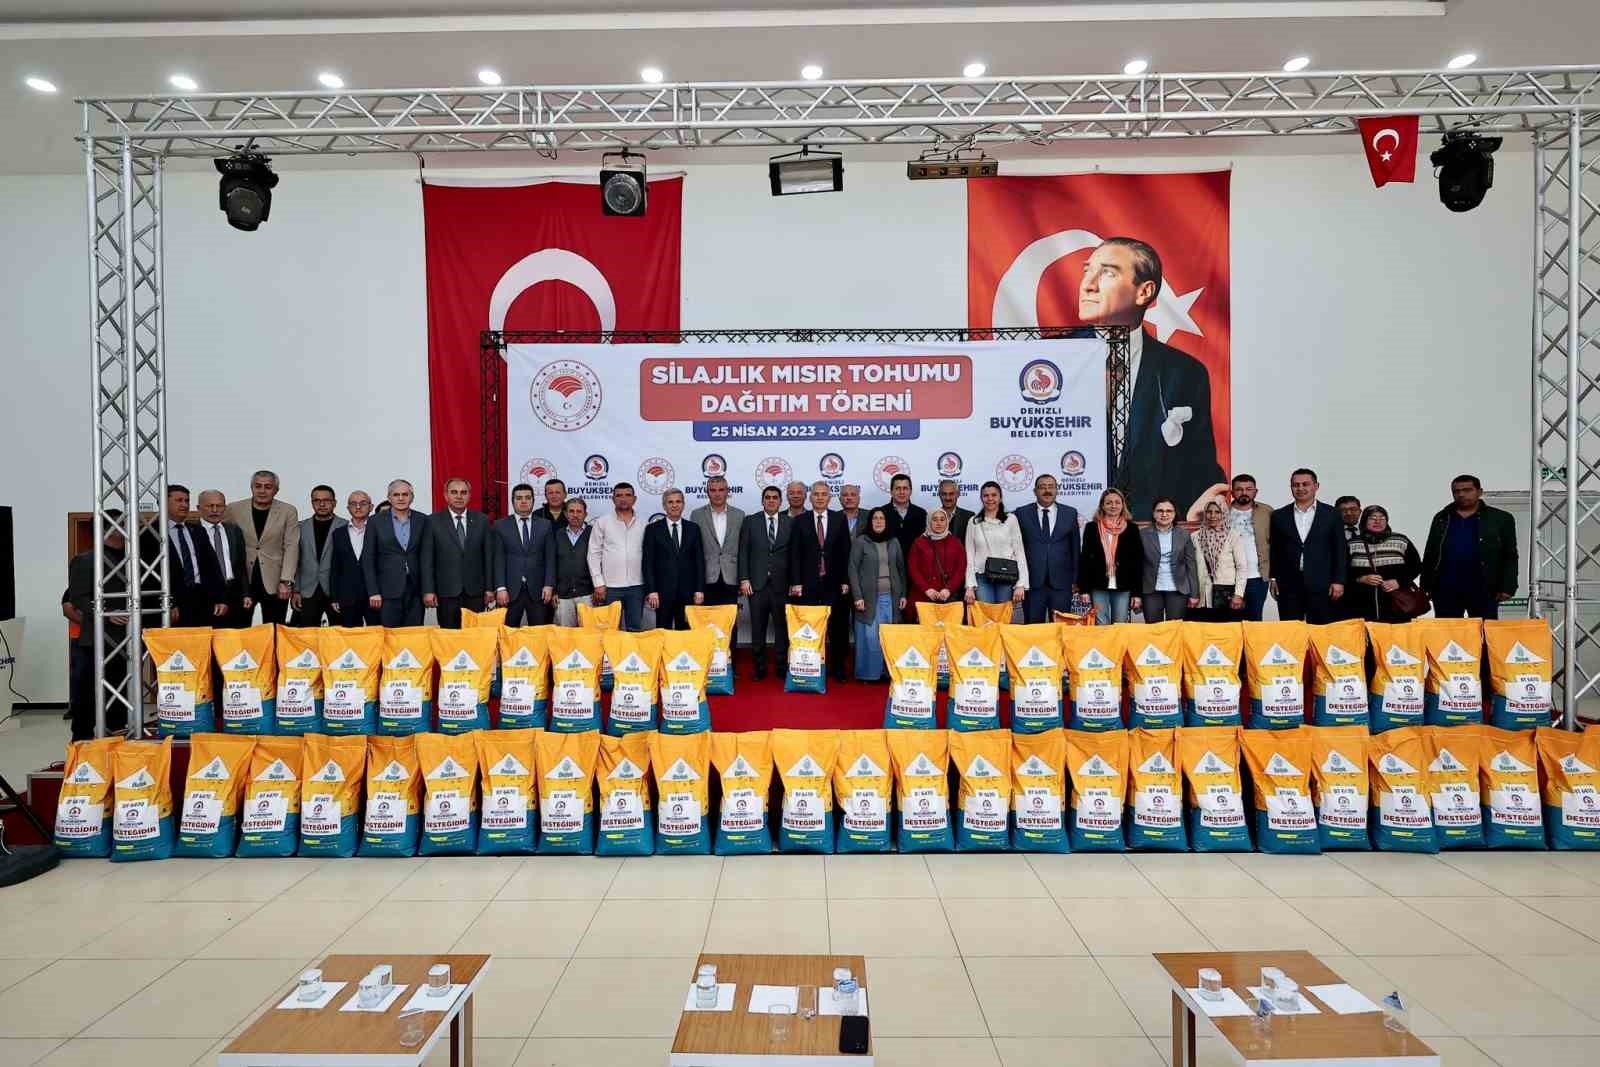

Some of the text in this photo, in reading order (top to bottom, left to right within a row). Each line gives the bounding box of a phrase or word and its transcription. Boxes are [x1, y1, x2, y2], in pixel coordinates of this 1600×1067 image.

[652, 362, 961, 385] SİLAJLIK MISIR TOHUMU
[701, 389, 912, 414] DAĞITIM TÖRENİ
[712, 427, 728, 437] 25
[732, 424, 777, 437] NİSAN
[781, 426, 816, 436] 2023
[828, 425, 901, 436] ACIPAYAM
